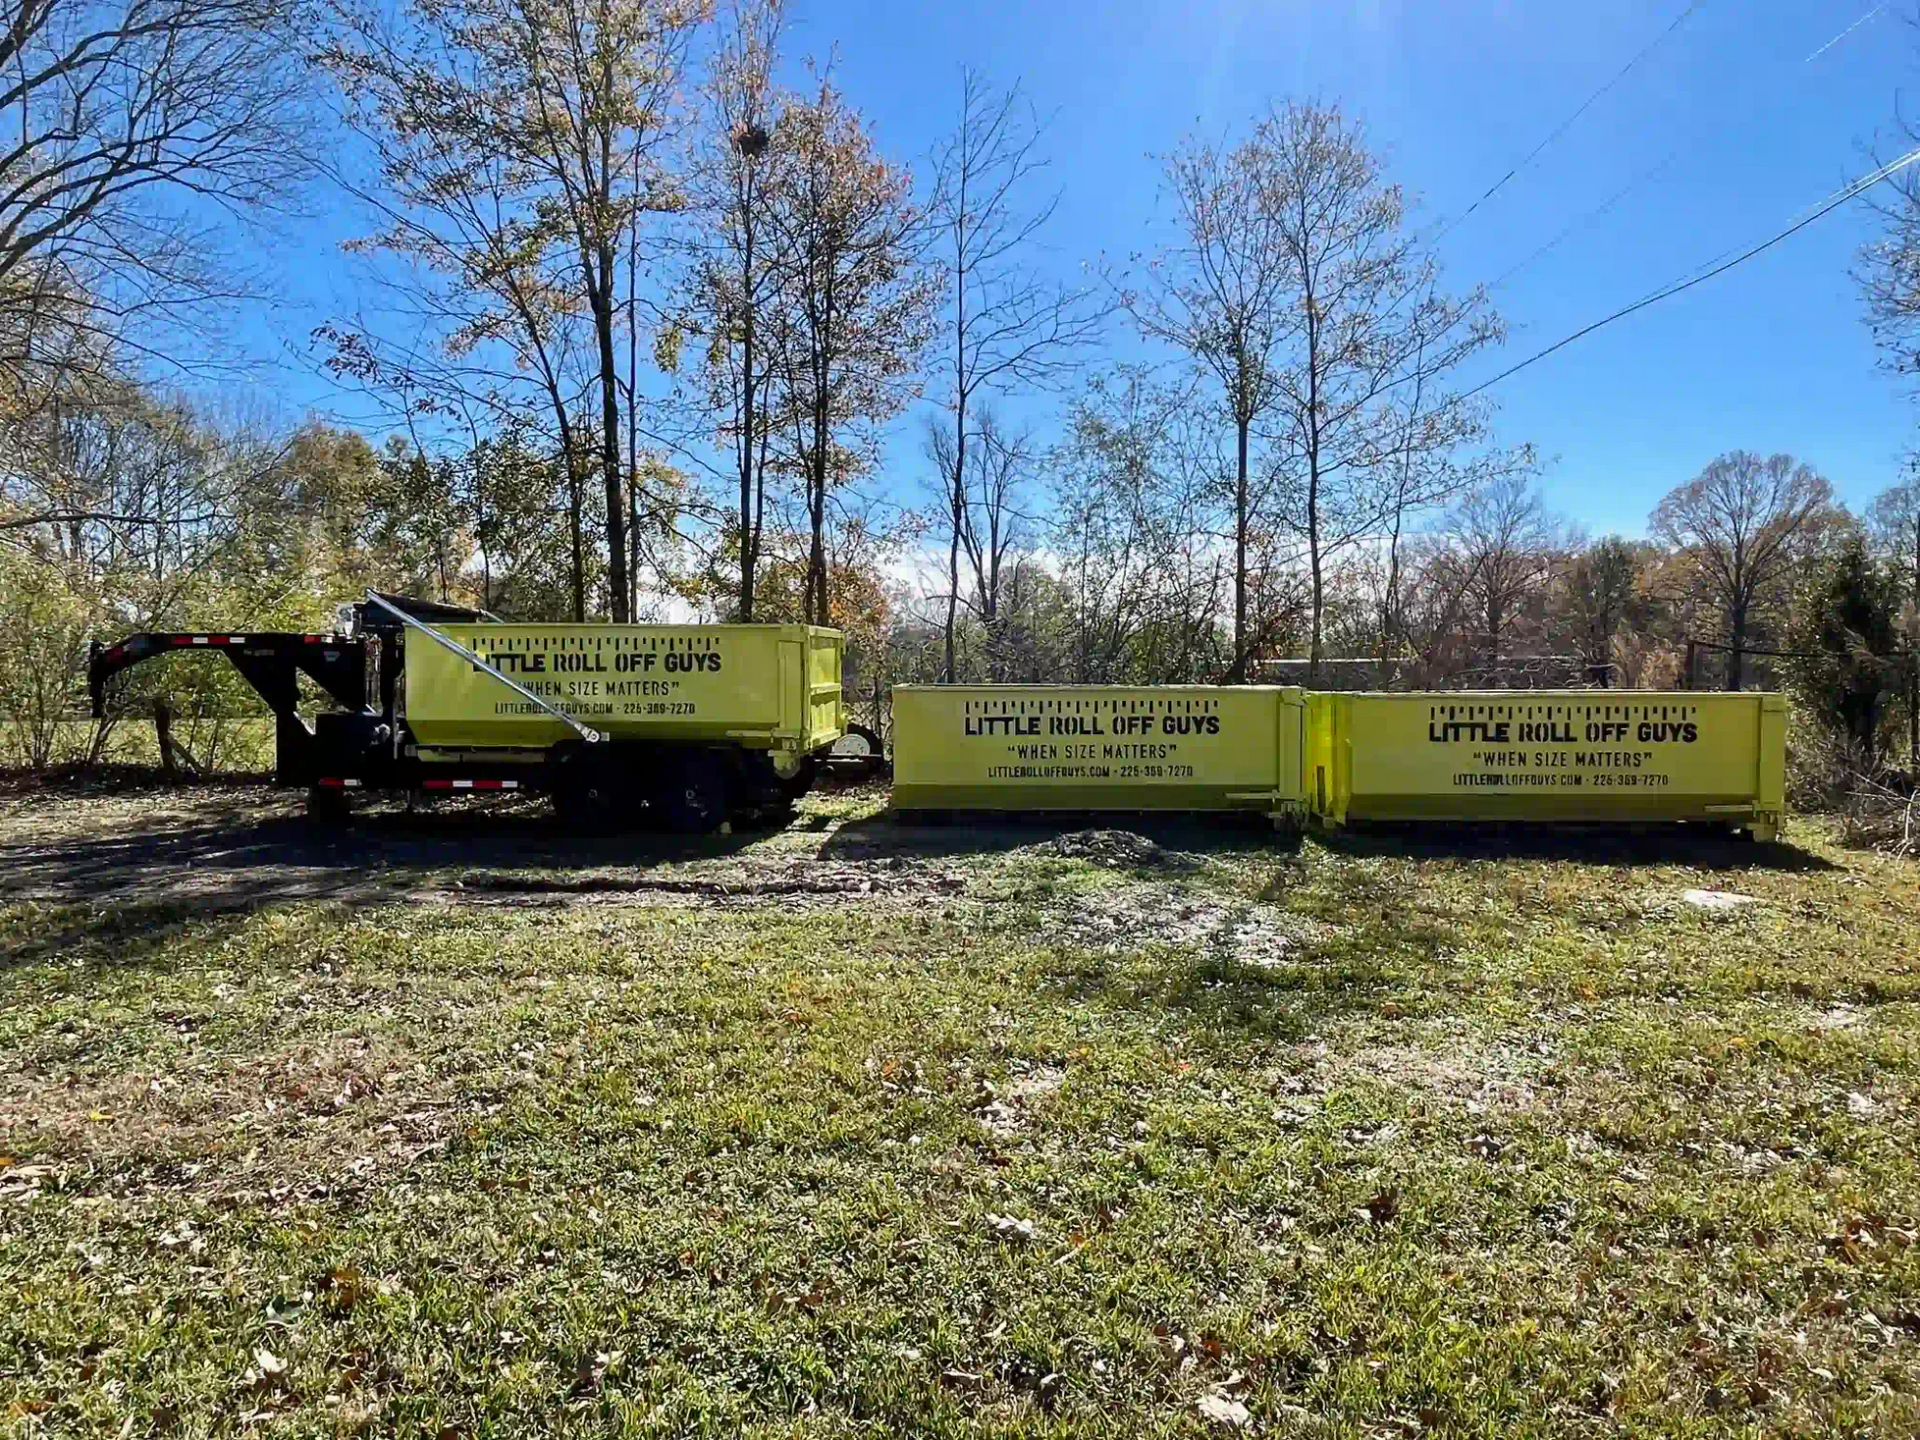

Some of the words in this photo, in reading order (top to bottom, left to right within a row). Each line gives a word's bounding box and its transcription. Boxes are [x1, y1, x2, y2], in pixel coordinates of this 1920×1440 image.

[473, 653, 546, 673] LITTLE
[554, 653, 608, 672] ROLL
[615, 653, 658, 673] OFF
[664, 652, 722, 673] GUYS
[568, 681, 599, 696] SIZE
[965, 716, 1041, 735] LITTLE
[1049, 716, 1105, 735] ROLL
[1112, 716, 1155, 735] OFF
[1162, 716, 1220, 735] GUYS
[1429, 722, 1510, 743] LITTLE
[1518, 722, 1578, 743] ROLL
[1586, 722, 1629, 743] OFF
[1637, 722, 1698, 743] GUYS
[1007, 744, 1058, 759] “WHEN
[1065, 744, 1096, 759] SIZE
[1103, 744, 1177, 759] MATTERS”
[1473, 751, 1527, 767] “WHEN
[1535, 751, 1567, 767] SIZE
[1575, 751, 1653, 767] MATTERS”
